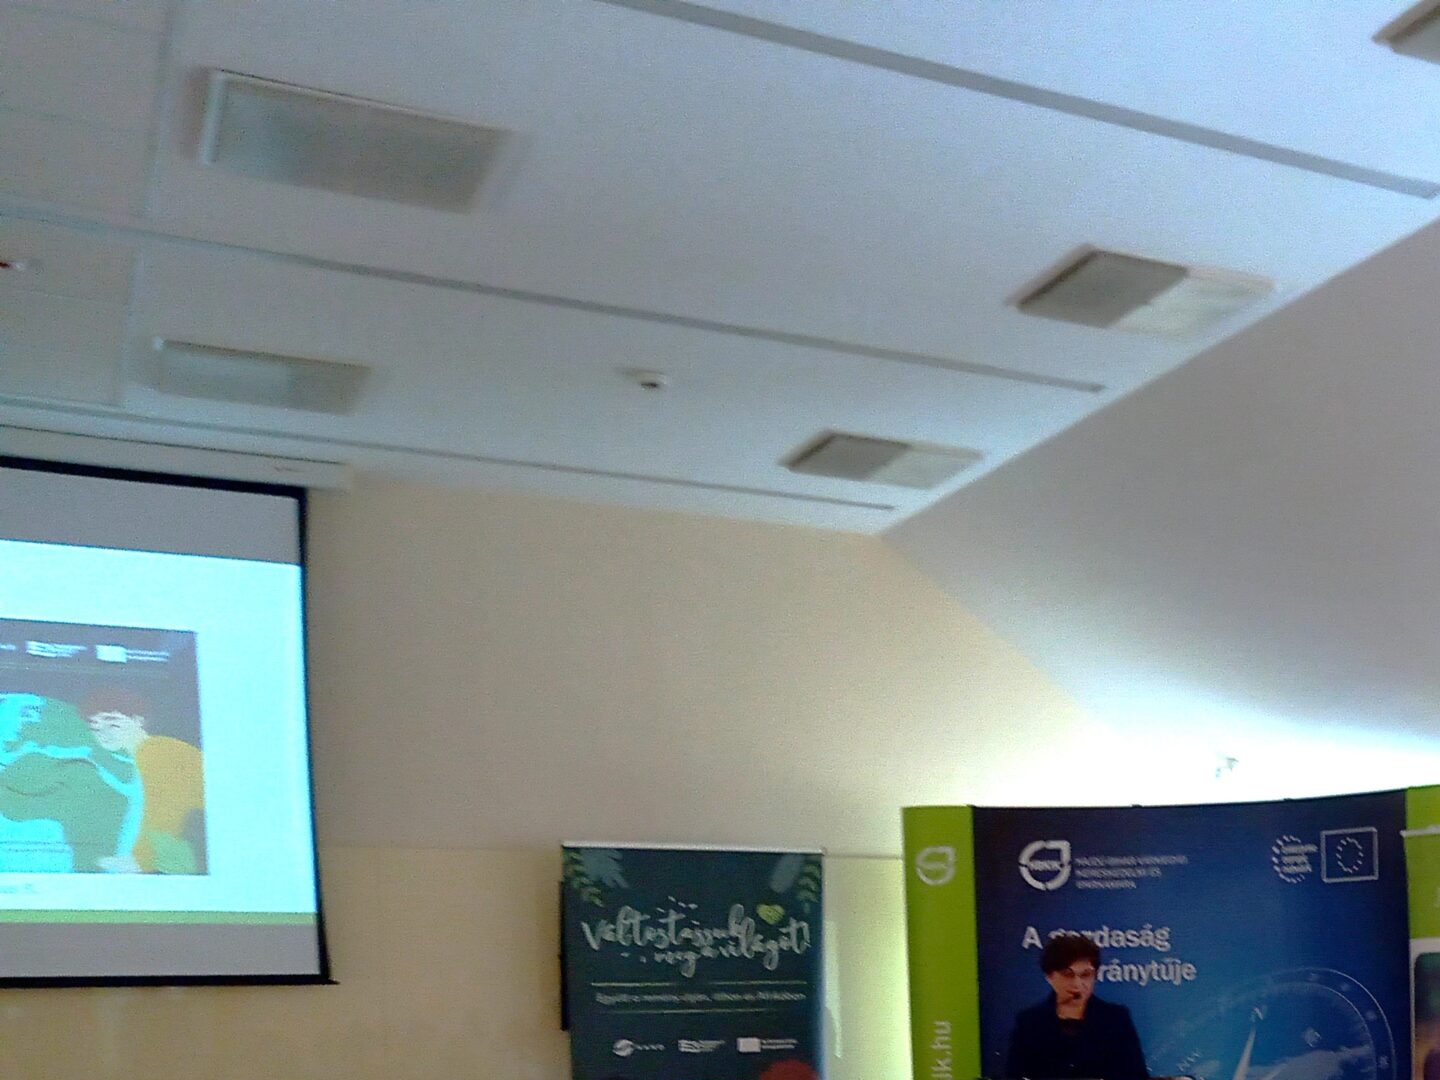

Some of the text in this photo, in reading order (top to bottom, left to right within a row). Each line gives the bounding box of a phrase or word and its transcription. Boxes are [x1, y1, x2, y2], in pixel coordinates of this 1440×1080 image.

[1022, 923, 1171, 951] A daság
[1096, 957, 1198, 986] ránytűje
